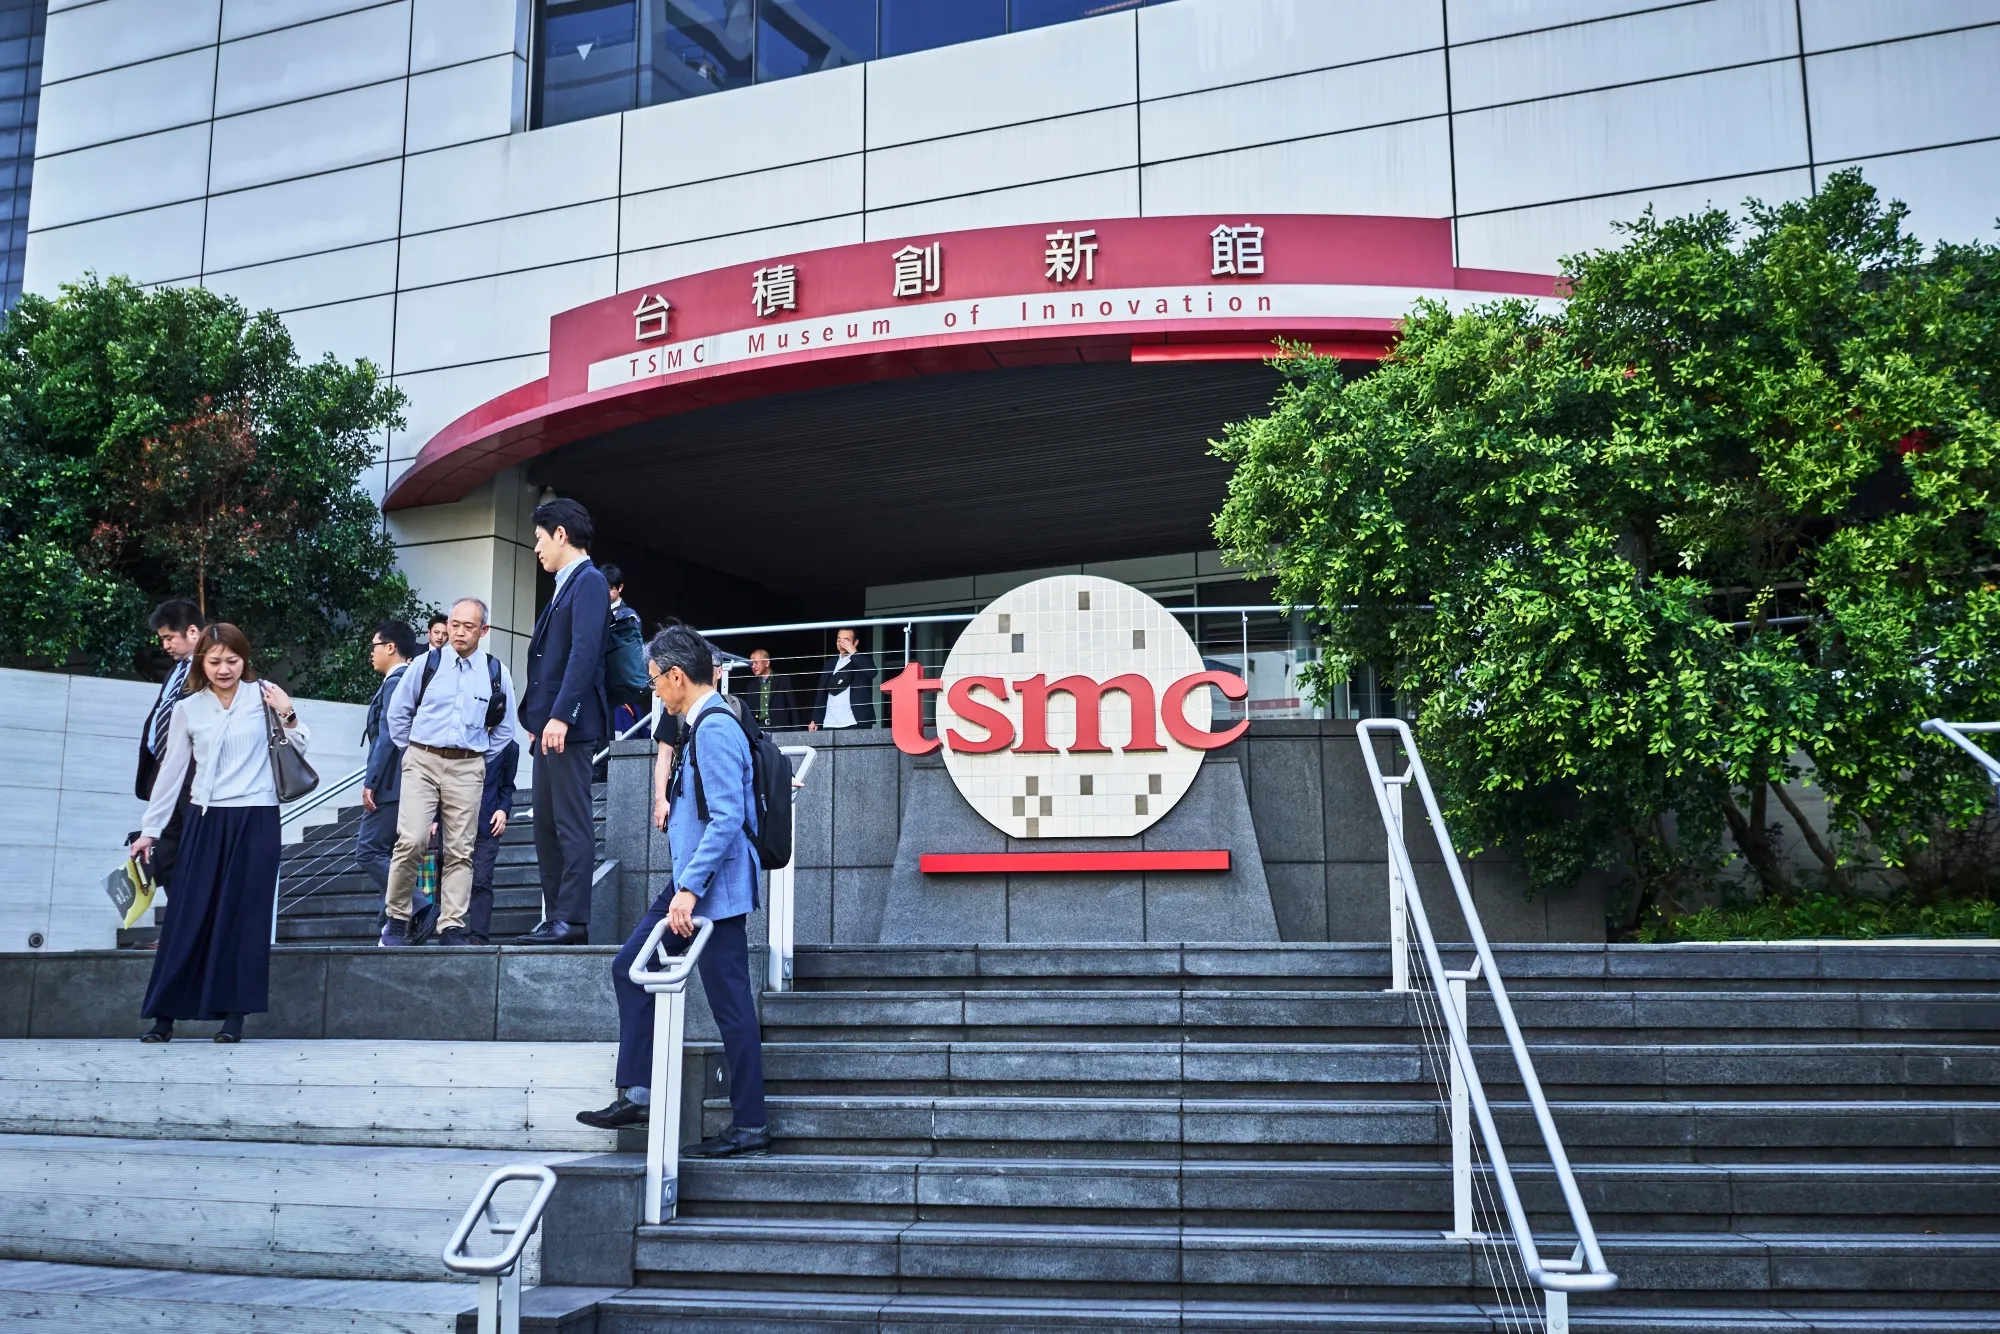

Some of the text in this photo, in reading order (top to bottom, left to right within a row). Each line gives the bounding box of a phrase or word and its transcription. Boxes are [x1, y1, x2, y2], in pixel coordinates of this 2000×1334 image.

[633, 223, 1265, 341] 台積創新館
[629, 292, 1271, 377] TSMC Museum of Innovation
[880, 662, 1251, 756] tsmc
